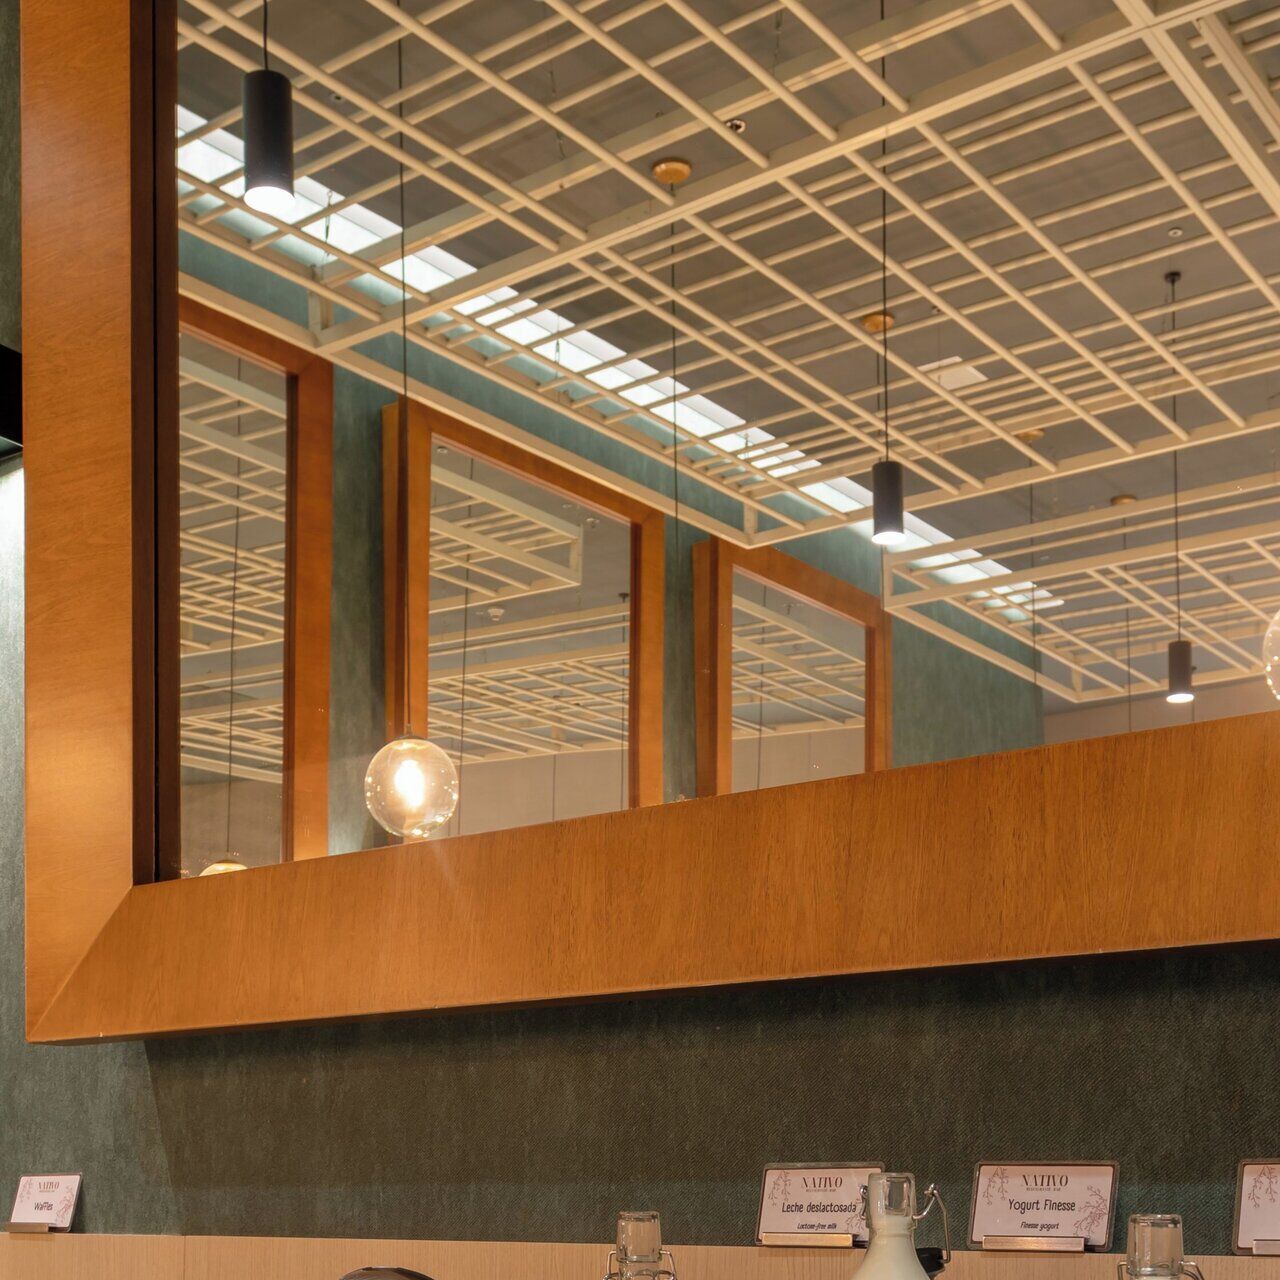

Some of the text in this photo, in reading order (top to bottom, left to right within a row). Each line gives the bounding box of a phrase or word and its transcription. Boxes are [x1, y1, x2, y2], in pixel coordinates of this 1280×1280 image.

[801, 1176, 843, 1188] NATIVO
[1021, 1174, 1068, 1187] NATIVO
[34, 1201, 54, 1211] Waffles
[782, 1201, 857, 1213] Leche deslactosada
[1008, 1198, 1076, 1214] Yogurt Finesse
[1040, 1222, 1059, 1231] yogurt
